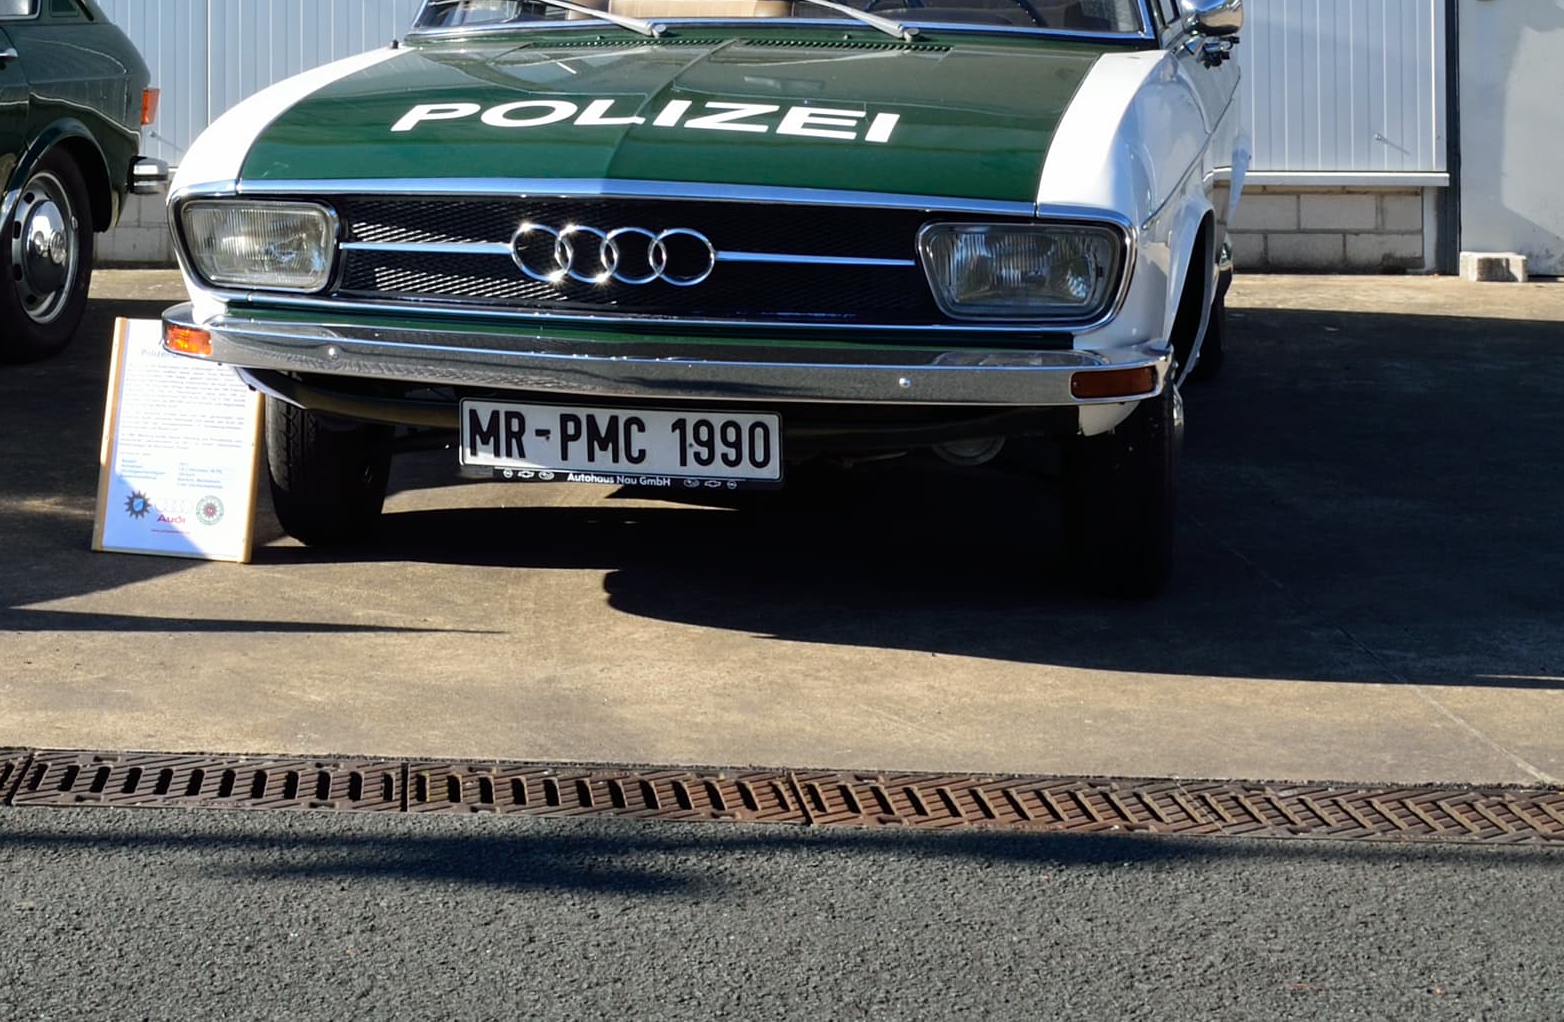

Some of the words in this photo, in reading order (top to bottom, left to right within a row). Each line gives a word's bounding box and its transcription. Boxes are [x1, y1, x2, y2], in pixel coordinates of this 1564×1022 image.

[389, 99, 901, 144] POLIZEI
[670, 417, 771, 469] 1990
[567, 472, 614, 485] Autohaus
[616, 474, 637, 486] Nau
[639, 476, 671, 487] GmbH
[157, 513, 186, 524] Audi
